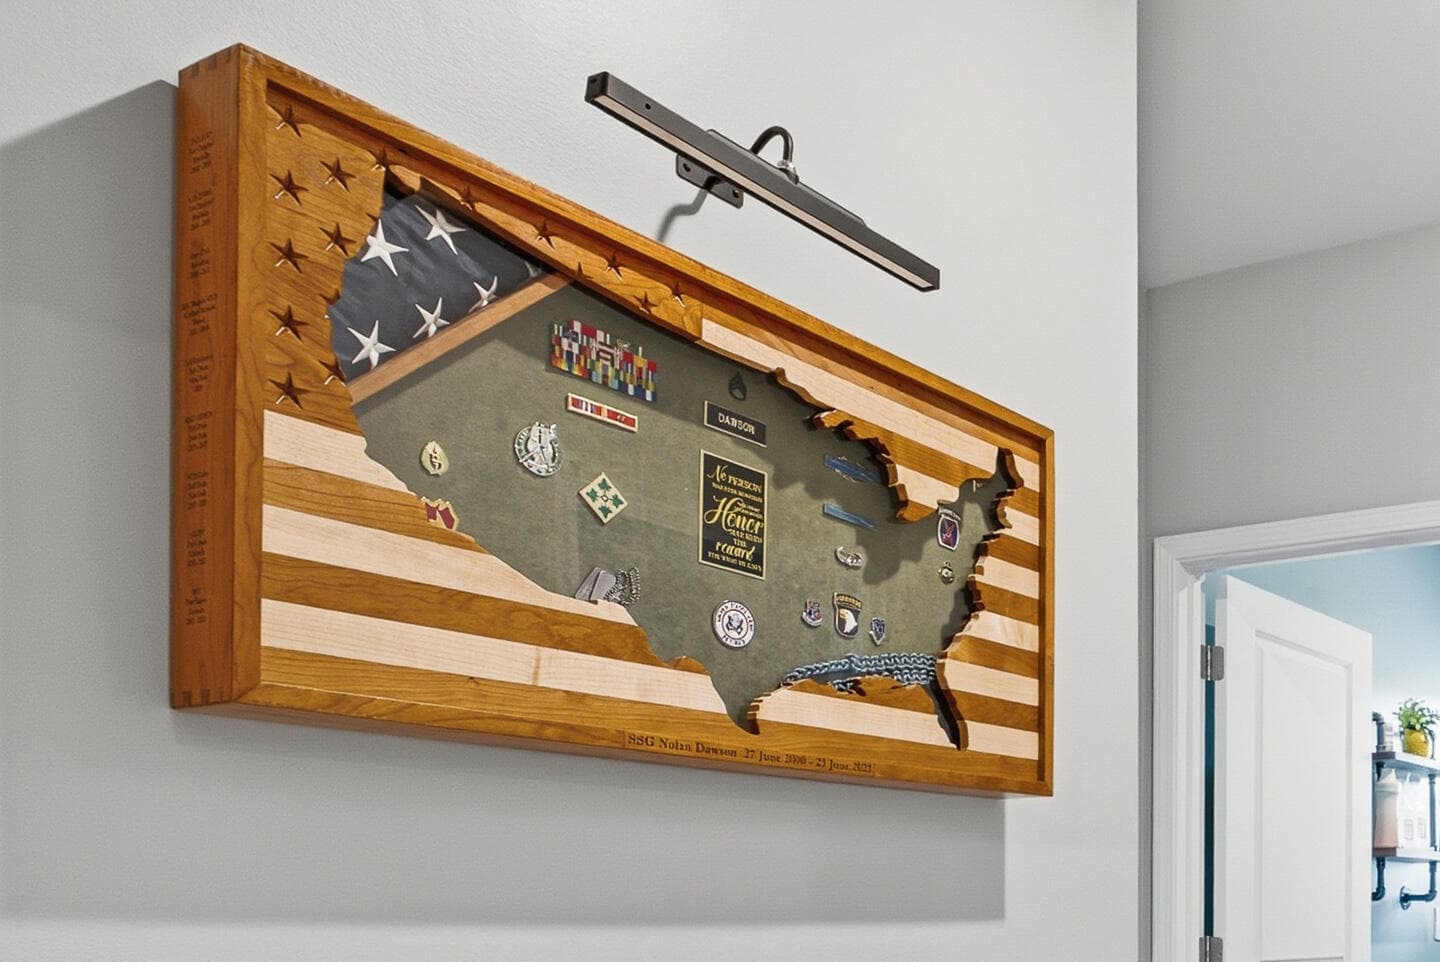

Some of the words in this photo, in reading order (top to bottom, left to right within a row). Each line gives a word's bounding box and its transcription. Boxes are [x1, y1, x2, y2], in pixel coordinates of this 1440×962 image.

[628, 734, 655, 747] SSG
[659, 738, 692, 753] Nolan
[695, 742, 737, 758] Dawson
